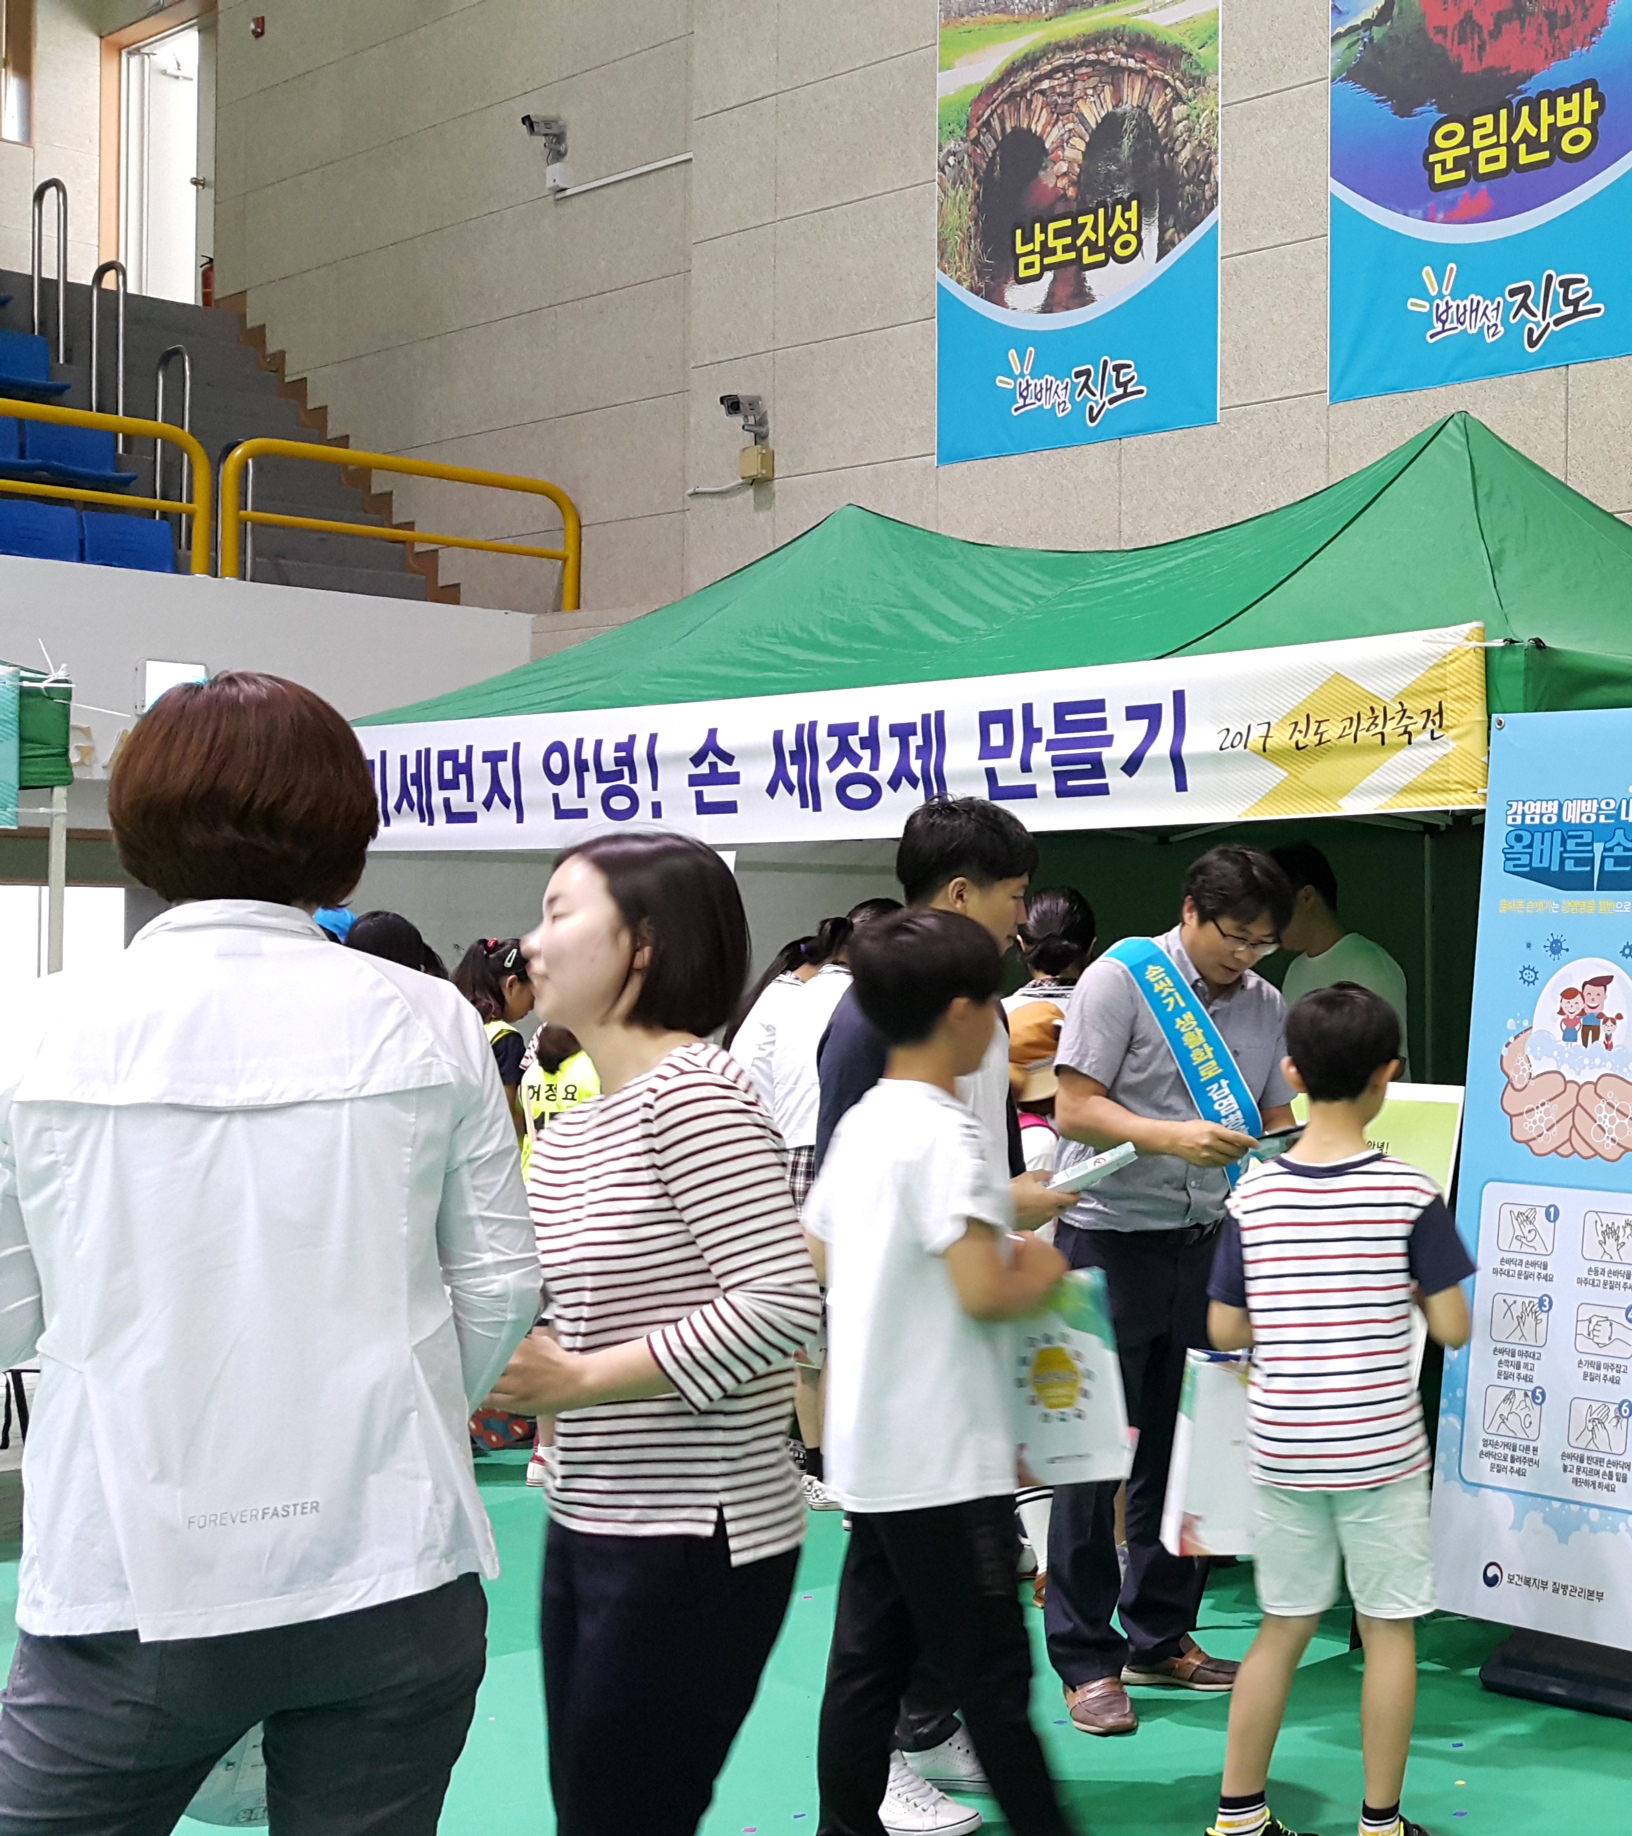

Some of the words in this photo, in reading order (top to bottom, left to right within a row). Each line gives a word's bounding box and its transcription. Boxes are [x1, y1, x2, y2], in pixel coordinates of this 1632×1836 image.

[1429, 88, 1599, 185] 운림산방
[1015, 200, 1138, 278] 남도진성
[1433, 296, 1501, 342] 보배섬
[1509, 273, 1603, 348] 진도
[1017, 372, 1071, 415] 보배섬
[1074, 361, 1146, 424] 진도
[1217, 721, 1274, 753] 2017
[542, 733, 662, 820] 안녕!
[688, 727, 740, 816] 손
[765, 708, 947, 815] 세정제
[978, 689, 1188, 802] 만들기
[1506, 799, 1559, 825] 감염병
[1562, 798, 1616, 824] 예방은
[1502, 829, 1594, 872] 올바른
[1145, 965, 1186, 1012] 손씻기
[1175, 1011, 1223, 1082] 생활화로
[1549, 1207, 1556, 1221] 1
[1541, 1298, 1550, 1310] 3
[1535, 1389, 1543, 1404] 5
[1621, 1402, 1630, 1417] 6
[187, 1500, 320, 1530] FOREVERFASTER
[1507, 1572, 1549, 1591] 보건복지부
[1551, 1581, 1604, 1602] 질병관리본부
